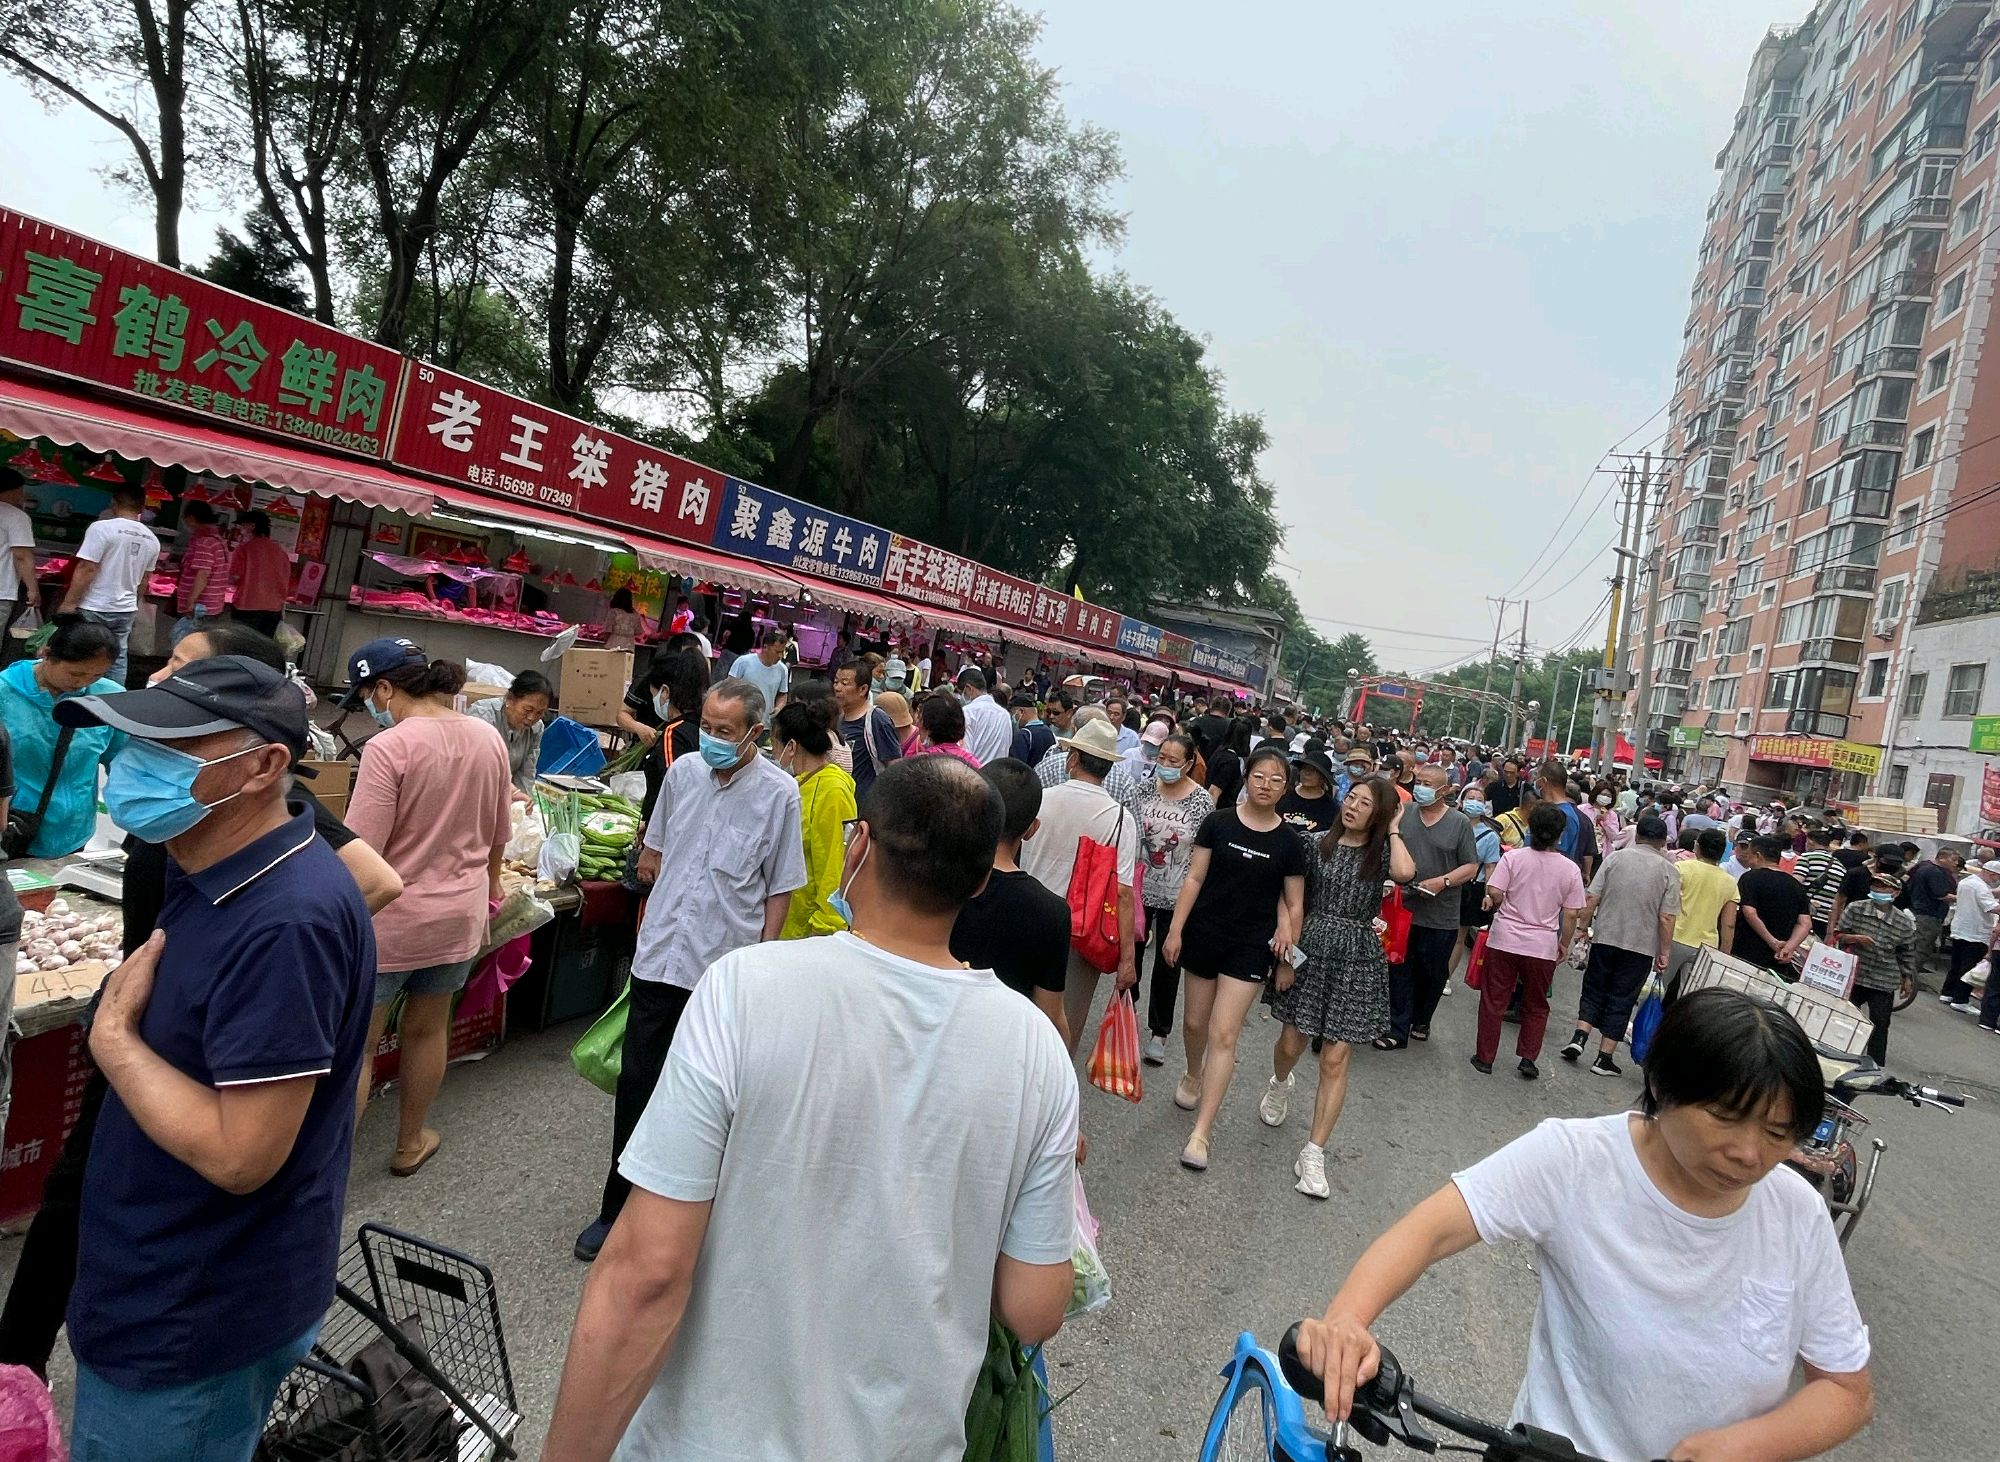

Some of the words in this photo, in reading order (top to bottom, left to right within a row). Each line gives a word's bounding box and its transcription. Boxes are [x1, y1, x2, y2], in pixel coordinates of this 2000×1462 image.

[0, 250, 386, 432] 喜鹤冷鲜肉
[419, 367, 435, 384] 50
[133, 368, 380, 456] 批发零售电话:13840024263
[427, 388, 711, 526] 老王笨猪肉
[540, 485, 573, 508] 07349
[737, 484, 747, 495] 53
[730, 493, 880, 571] 聚鑫源牛肉
[885, 545, 975, 597] 西丰笨猪肉
[972, 574, 1032, 617] 洪新鲜肉店
[1035, 592, 1067, 625] 猪下货
[1076, 608, 1113, 640] 鲜肉店
[356, 659, 370, 678] 3
[30, 967, 93, 998] 4.5
